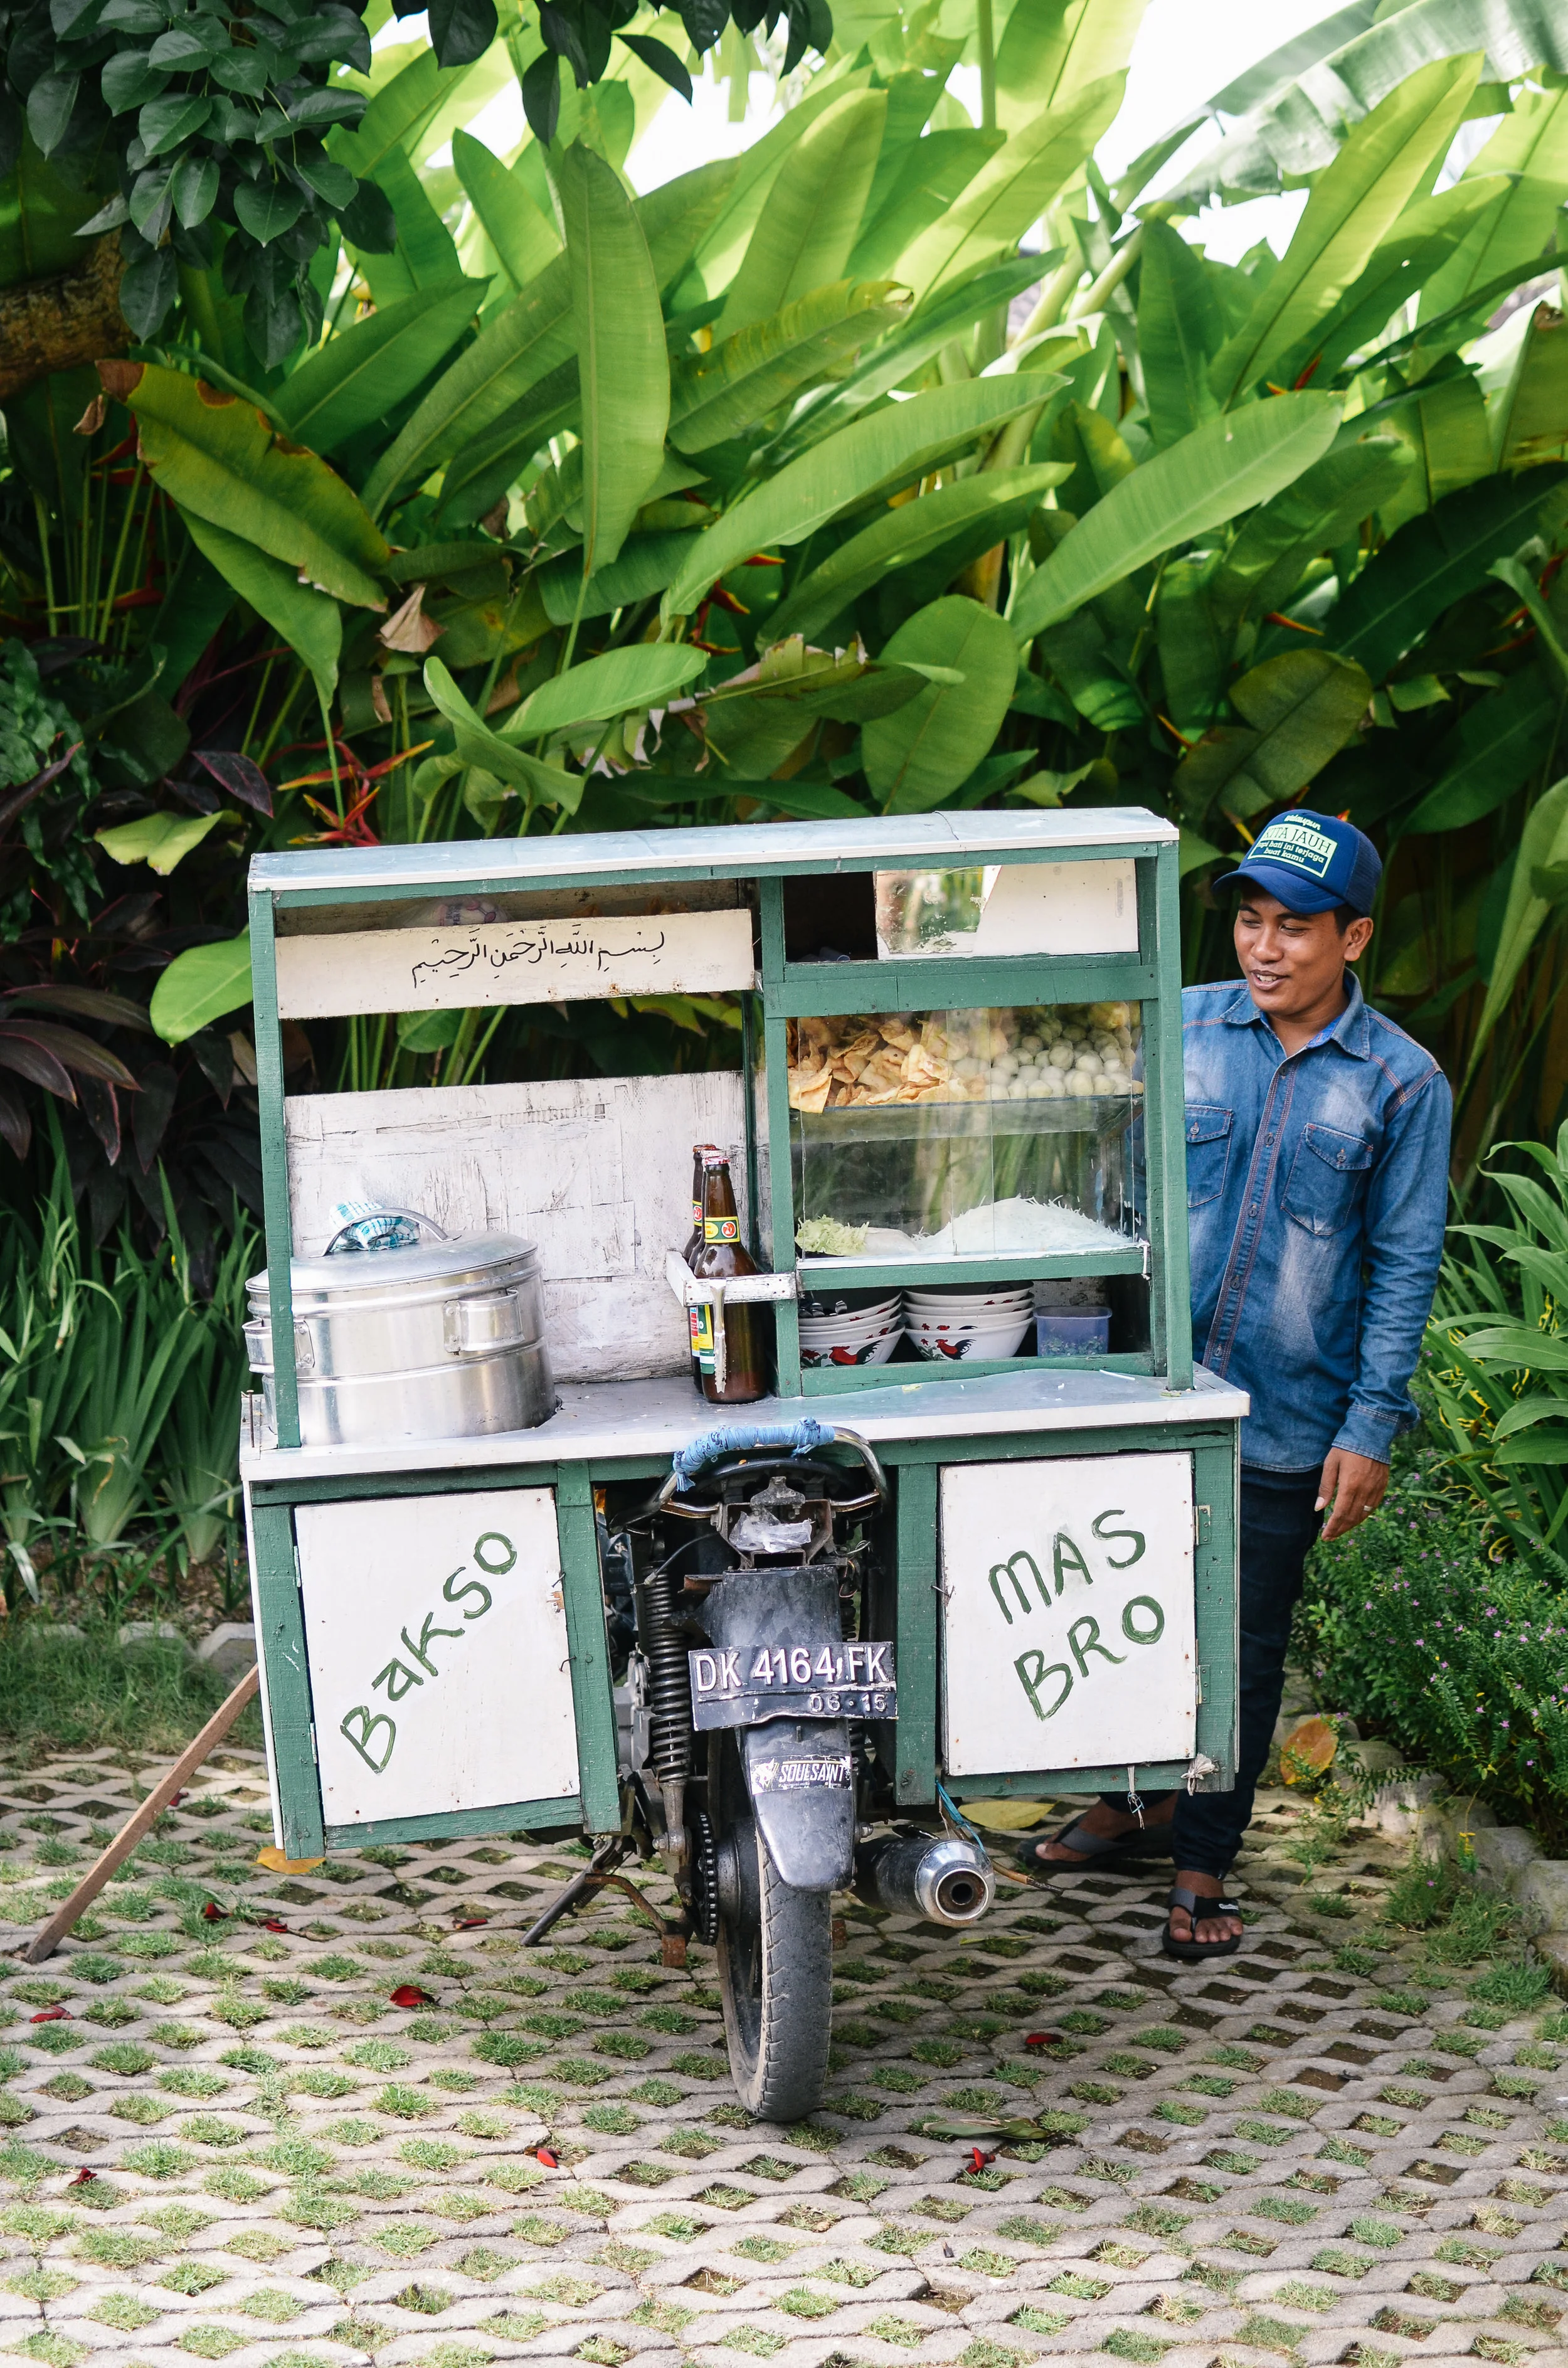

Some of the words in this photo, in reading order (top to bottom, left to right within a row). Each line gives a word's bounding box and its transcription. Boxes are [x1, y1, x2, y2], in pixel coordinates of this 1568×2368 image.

[1263, 827, 1288, 839] KITA
[1290, 829, 1332, 854] JAUH
[1263, 847, 1281, 856] buat
[1281, 849, 1305, 863] kamu
[1269, 841, 1284, 849] hati
[1283, 841, 1295, 851] ini
[1295, 846, 1325, 863] terjaga
[988, 1509, 1146, 1625] MAS
[694, 1654, 743, 1692] DK
[753, 1647, 836, 1686] 4164
[848, 1646, 889, 1682] FK
[1014, 1595, 1165, 1721] BRO
